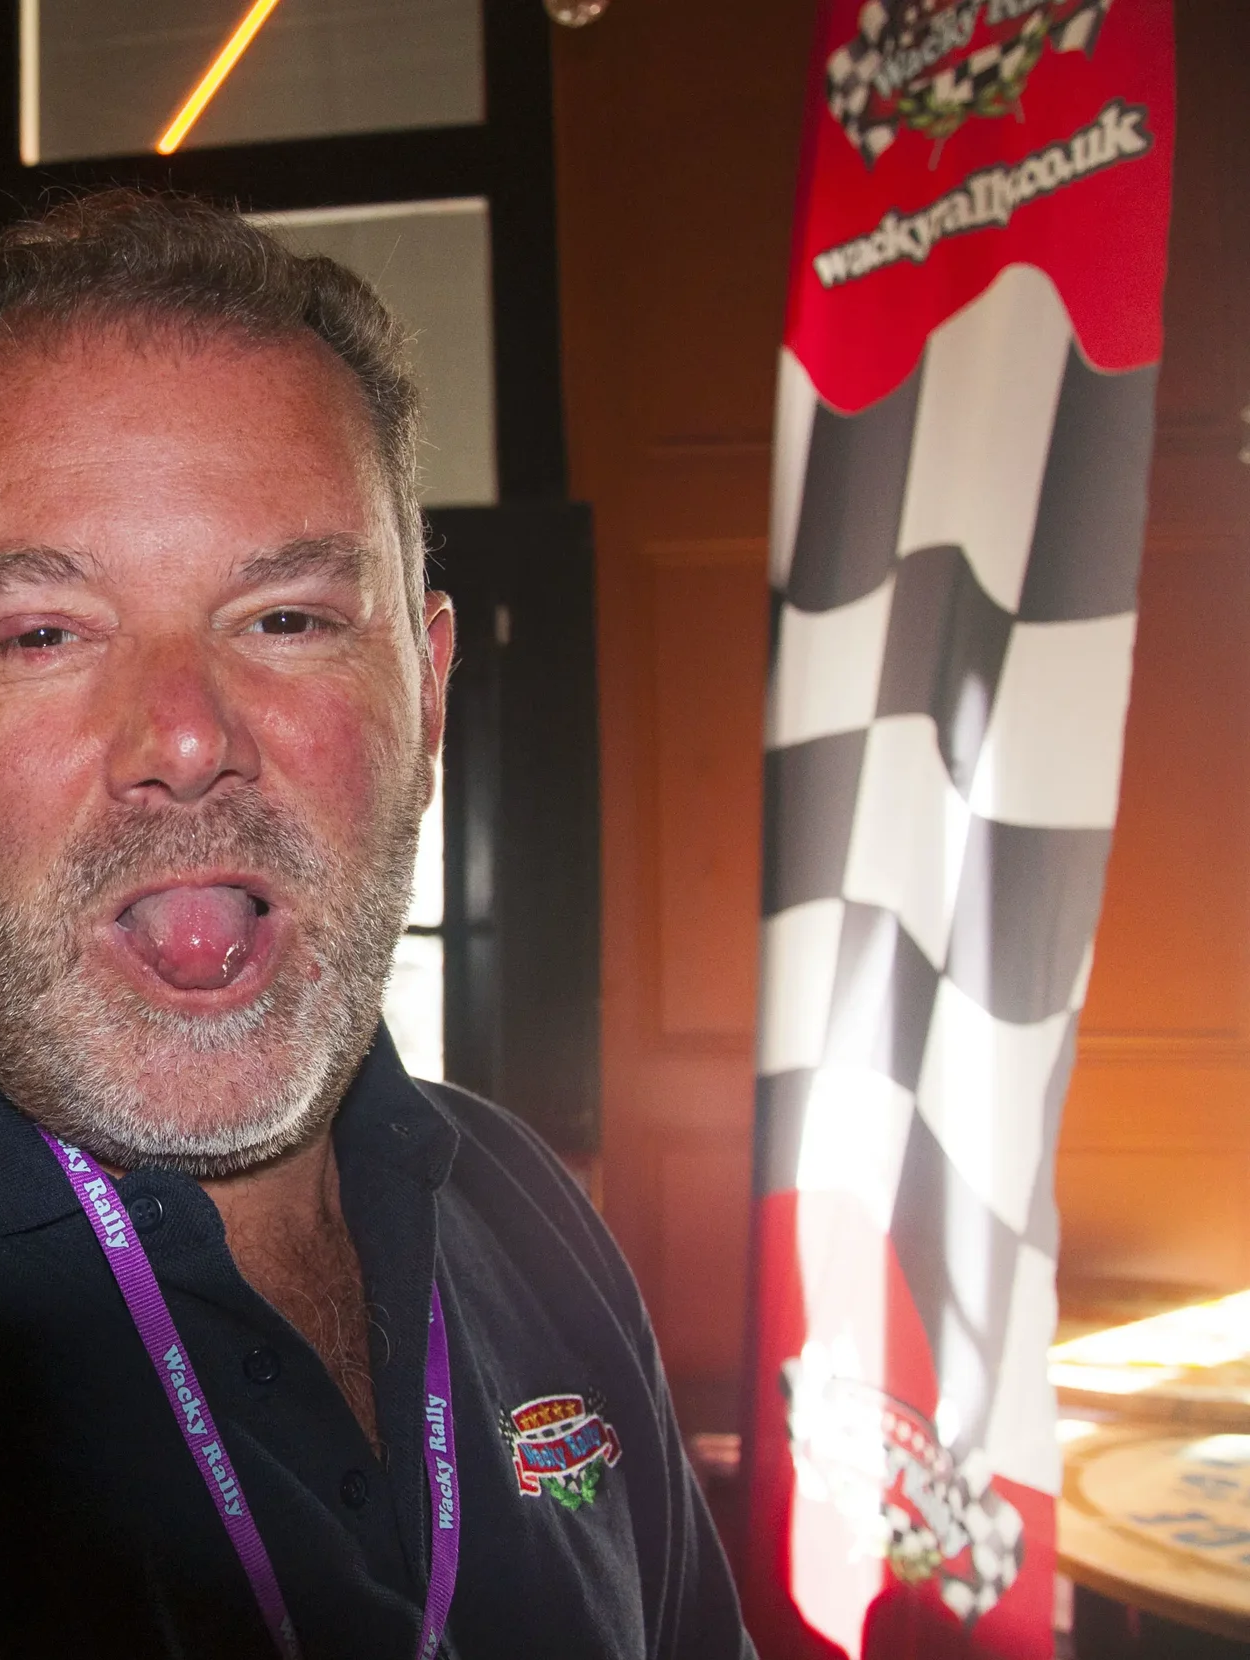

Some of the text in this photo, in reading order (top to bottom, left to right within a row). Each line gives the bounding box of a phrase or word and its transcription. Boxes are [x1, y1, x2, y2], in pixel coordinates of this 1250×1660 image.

[83, 1176, 130, 1249] Rally
[162, 1343, 243, 1517] Wacky Rally
[425, 1393, 454, 1530] Wacky Rally
